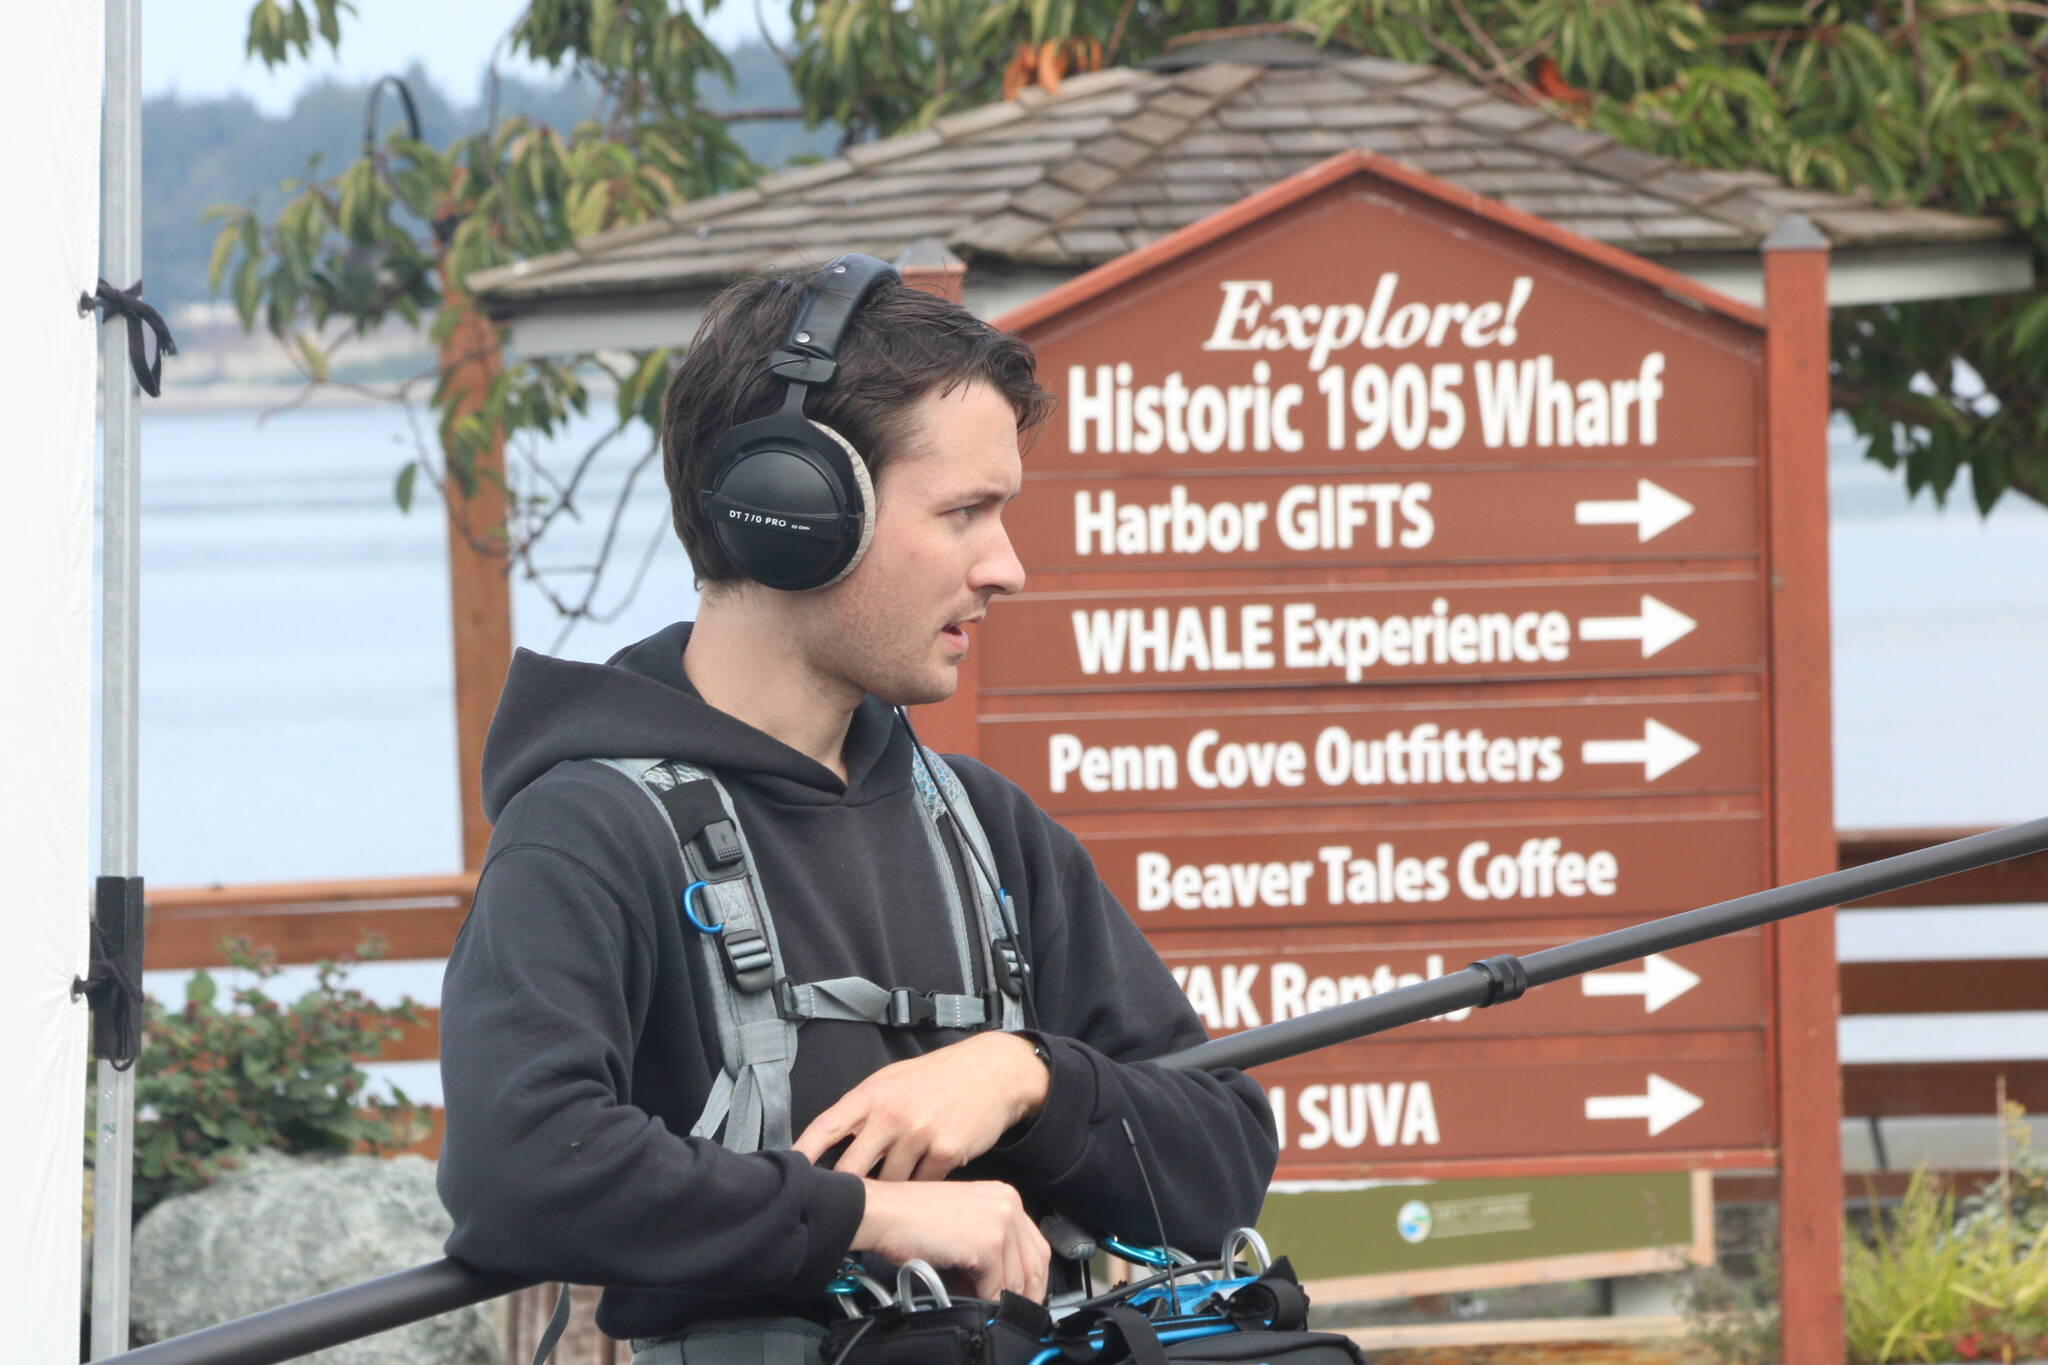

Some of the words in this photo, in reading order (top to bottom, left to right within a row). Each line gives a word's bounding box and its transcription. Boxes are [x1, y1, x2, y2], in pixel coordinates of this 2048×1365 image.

[1203, 273, 1532, 371] Explore!
[1068, 361, 1304, 454] Historic
[1319, 362, 1465, 453] 1905
[1474, 352, 1664, 448] Wharf
[729, 509, 742, 519] DT
[765, 517, 787, 527] PRO
[1074, 485, 1268, 555] Harbor
[1276, 482, 1434, 551] GIFTS
[1072, 605, 1275, 674] WHALE
[1284, 598, 1570, 683] Experience
[1049, 734, 1178, 793] Penn
[1187, 730, 1306, 788] Cove
[1315, 724, 1563, 785] Outfitters
[1137, 852, 1313, 912] Beaver
[1319, 843, 1450, 905] Tales
[1458, 837, 1618, 900] Coffee
[1297, 1081, 1441, 1150] SUVA
